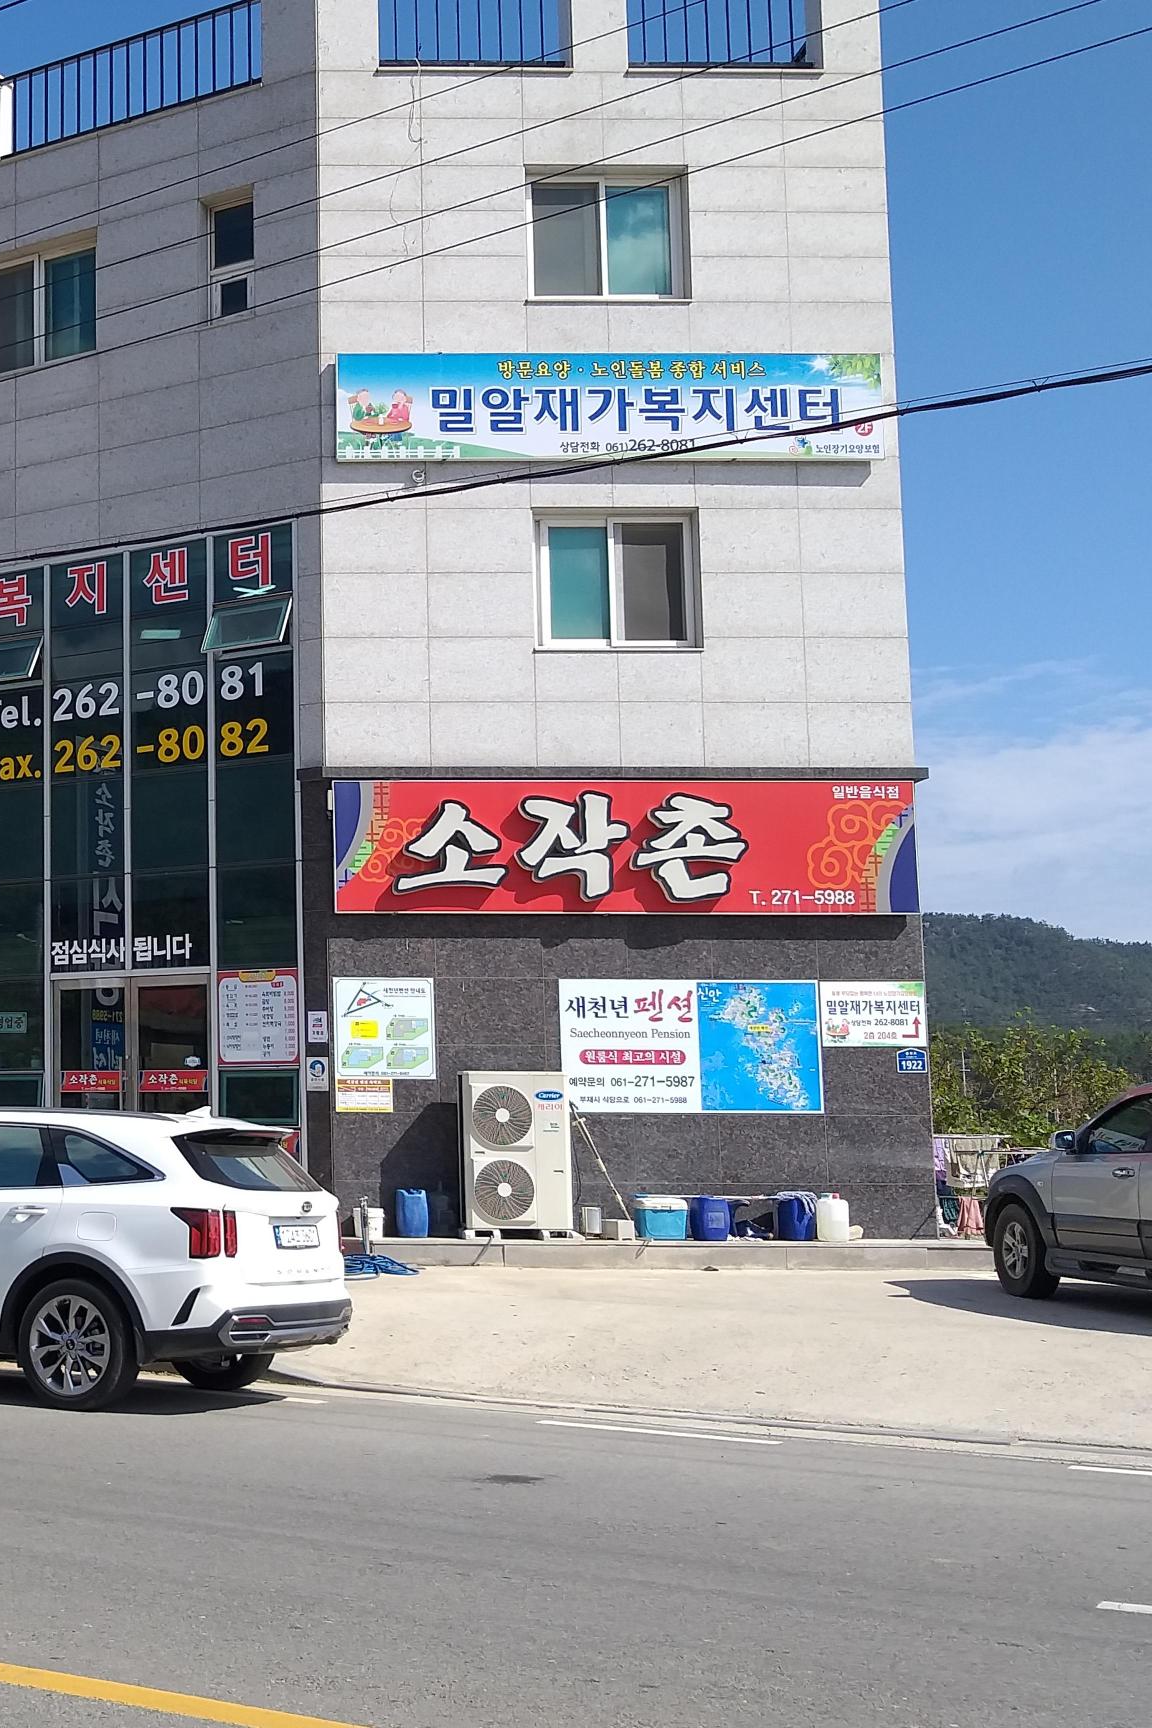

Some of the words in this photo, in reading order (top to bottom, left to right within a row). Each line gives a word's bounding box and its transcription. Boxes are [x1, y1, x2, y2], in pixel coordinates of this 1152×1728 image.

[498, 360, 571, 379] 방문요양
[591, 361, 664, 379] 노인돌봄
[670, 361, 705, 379] 종합
[711, 361, 766, 379] 서비스
[430, 387, 840, 433] 밀알재가복지센터
[560, 441, 600, 453] 상담전화
[816, 444, 880, 454] 노인장기요양보험
[832, 785, 900, 800] 일반음식점
[393, 790, 749, 902] 소작촌
[771, 889, 856, 905] 271-5988
[51, 936, 125, 965] 점심식사
[133, 934, 192, 961] 됩니다
[697, 986, 722, 1002] 신안
[565, 996, 629, 1019] 새천년
[634, 989, 693, 1022] 펜션
[826, 1000, 920, 1015] 밀알재가복지센터
[874, 1018, 908, 1026] 262-8081
[570, 1028, 648, 1040] Saecheonnyeon
[651, 1028, 690, 1039] Pension
[622, 1050, 655, 1063] 최고의
[659, 1050, 682, 1064] 시설
[901, 1060, 923, 1070] 1922
[69, 1074, 98, 1085] 소작촌
[149, 1073, 178, 1085] 소작촌
[569, 1077, 605, 1087] 예약문의
[611, 1075, 695, 1087] 061-271-5987
[634, 1096, 687, 1104] 061-271-5988
